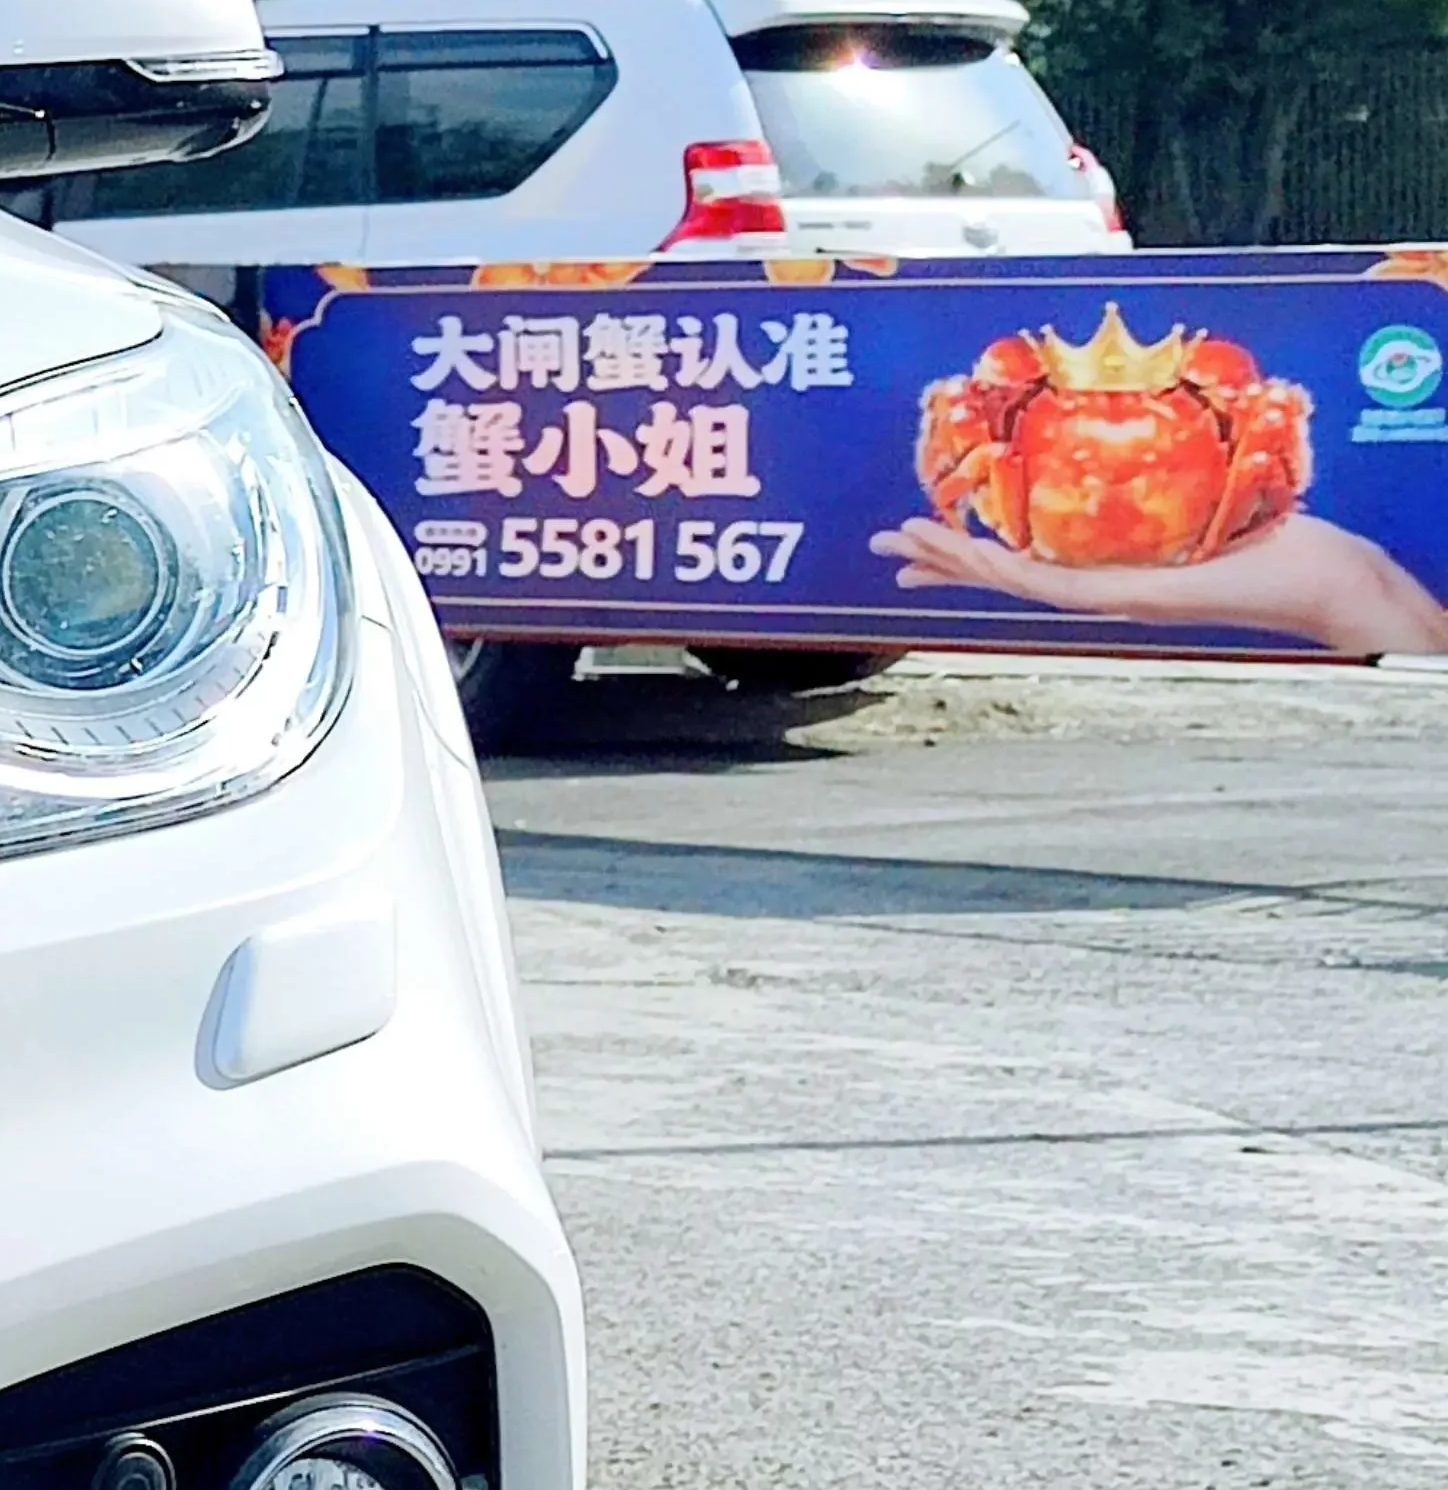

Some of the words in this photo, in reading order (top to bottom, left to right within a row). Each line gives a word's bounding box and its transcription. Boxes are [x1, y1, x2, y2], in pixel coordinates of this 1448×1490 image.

[411, 313, 854, 393] 大闸蟹认准
[411, 398, 761, 499] 蟹小姐
[415, 546, 487, 577] 0991
[499, 517, 655, 581] 5581
[674, 521, 805, 583] 567
